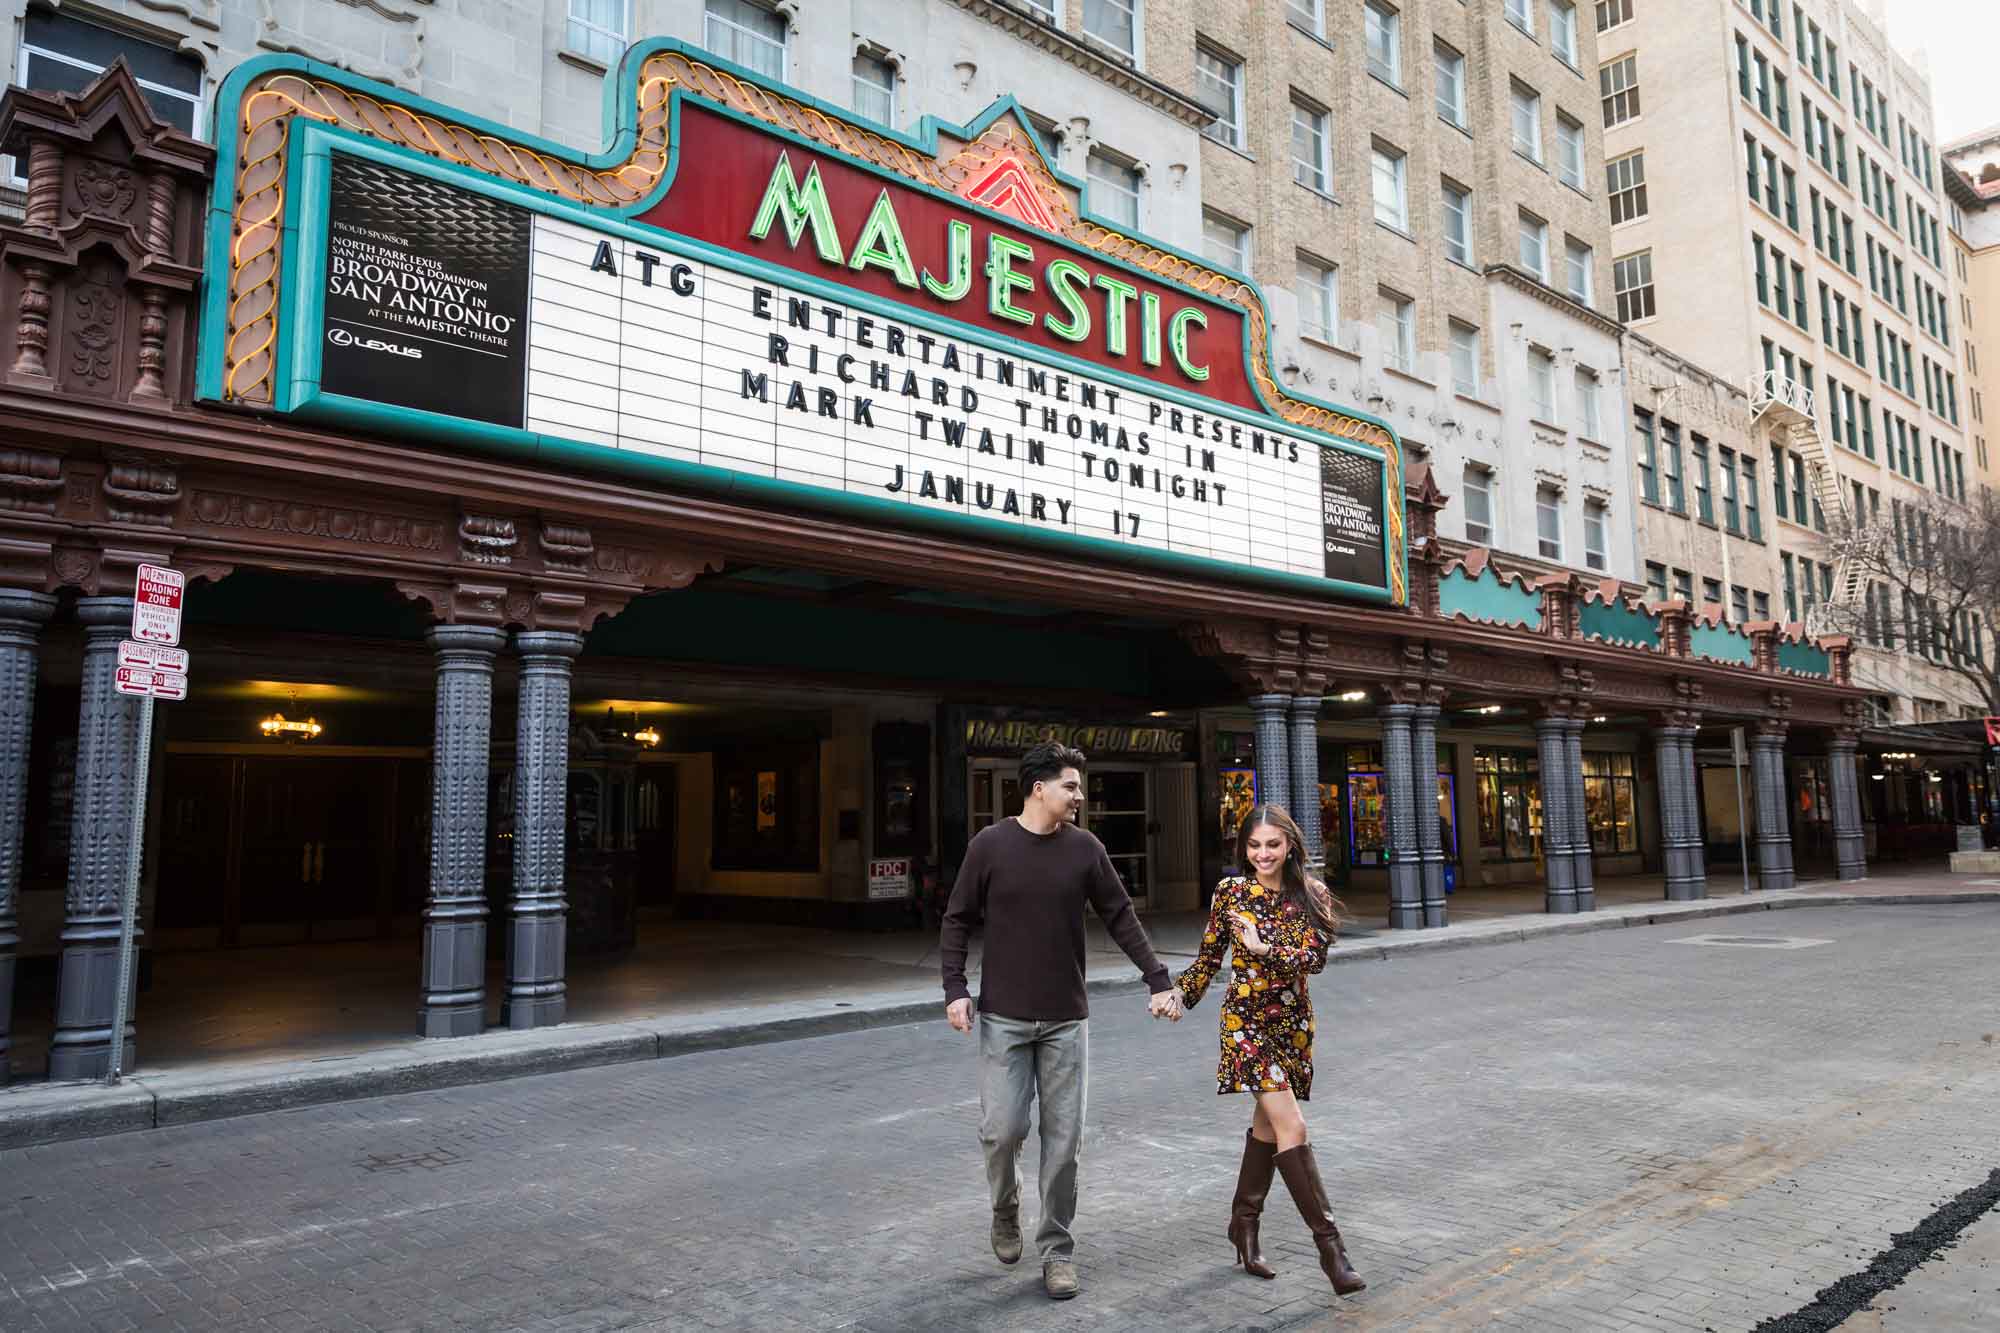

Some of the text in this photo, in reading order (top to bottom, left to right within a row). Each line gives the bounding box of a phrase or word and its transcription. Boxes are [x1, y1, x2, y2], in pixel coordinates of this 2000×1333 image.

[333, 221, 409, 247] PROUD SPONSOR
[332, 236, 442, 270] NORTH PARK LEXUS
[748, 148, 1210, 382] MAJESTIC
[332, 246, 488, 291] SAN ANTONIO & DOMINION
[329, 276, 383, 304] SAN
[332, 256, 487, 309] BROADWAY IN
[368, 308, 509, 347] AT THE MAJESTIC THEATRE
[354, 336, 423, 359] LEXUS
[590, 240, 1299, 463] ATG ENTERTAINMENT PRESENTS
[767, 332, 1216, 473] RICHARD THOMAS IN
[741, 368, 1226, 506] MARK TWAIN TONIGHT
[885, 464, 1140, 538] JANUARY 17
[1324, 503, 1367, 521] BROADWAY
[1324, 513, 1341, 526] SAN
[140, 566, 151, 580] NO
[141, 581, 179, 597] LOADING
[147, 593, 171, 606] ZONE
[141, 612, 176, 623] VEHICLES
[148, 621, 167, 630] ONLY
[122, 644, 185, 664] PASSENGER FREIGHT
[119, 669, 130, 680] 15
[152, 675, 164, 685] 30
[1093, 727, 1184, 753] BUILDING
[876, 863, 902, 876] FDC
